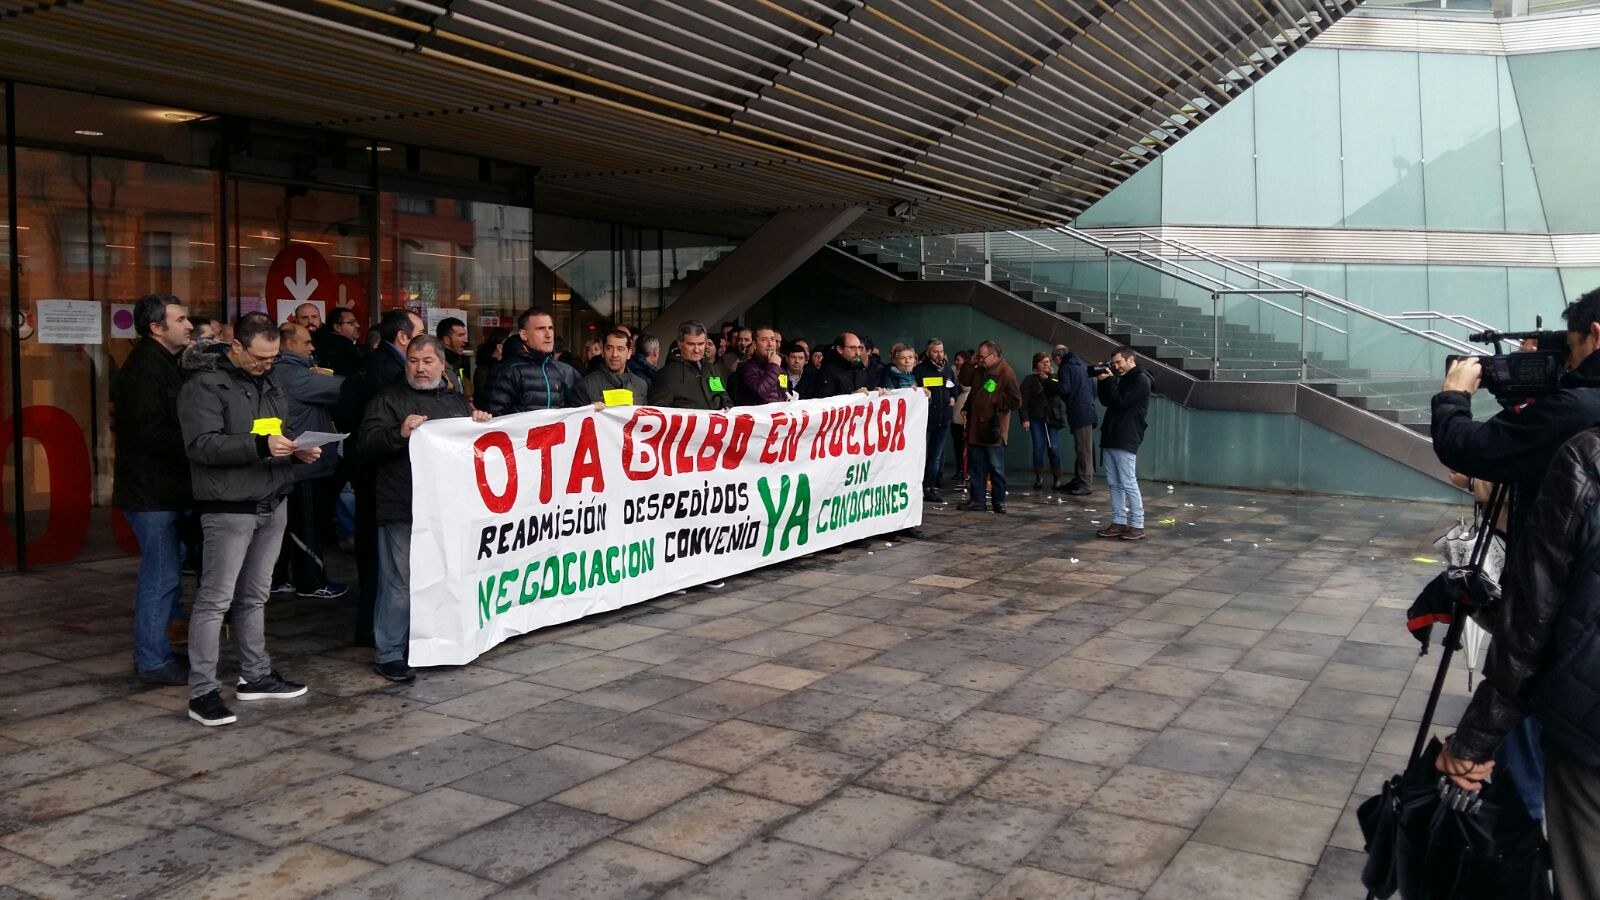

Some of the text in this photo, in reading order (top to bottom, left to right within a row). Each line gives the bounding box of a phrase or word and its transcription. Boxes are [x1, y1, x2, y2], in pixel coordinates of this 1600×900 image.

[474, 398, 906, 514] OTA BILBO EN HUELGA
[844, 460, 871, 486] SIN
[624, 480, 748, 524] DESPEDIDOS
[757, 473, 811, 557] YA
[816, 482, 909, 534] CONDICIONES
[478, 515, 761, 629] NEGOCIACION CONVENIO
